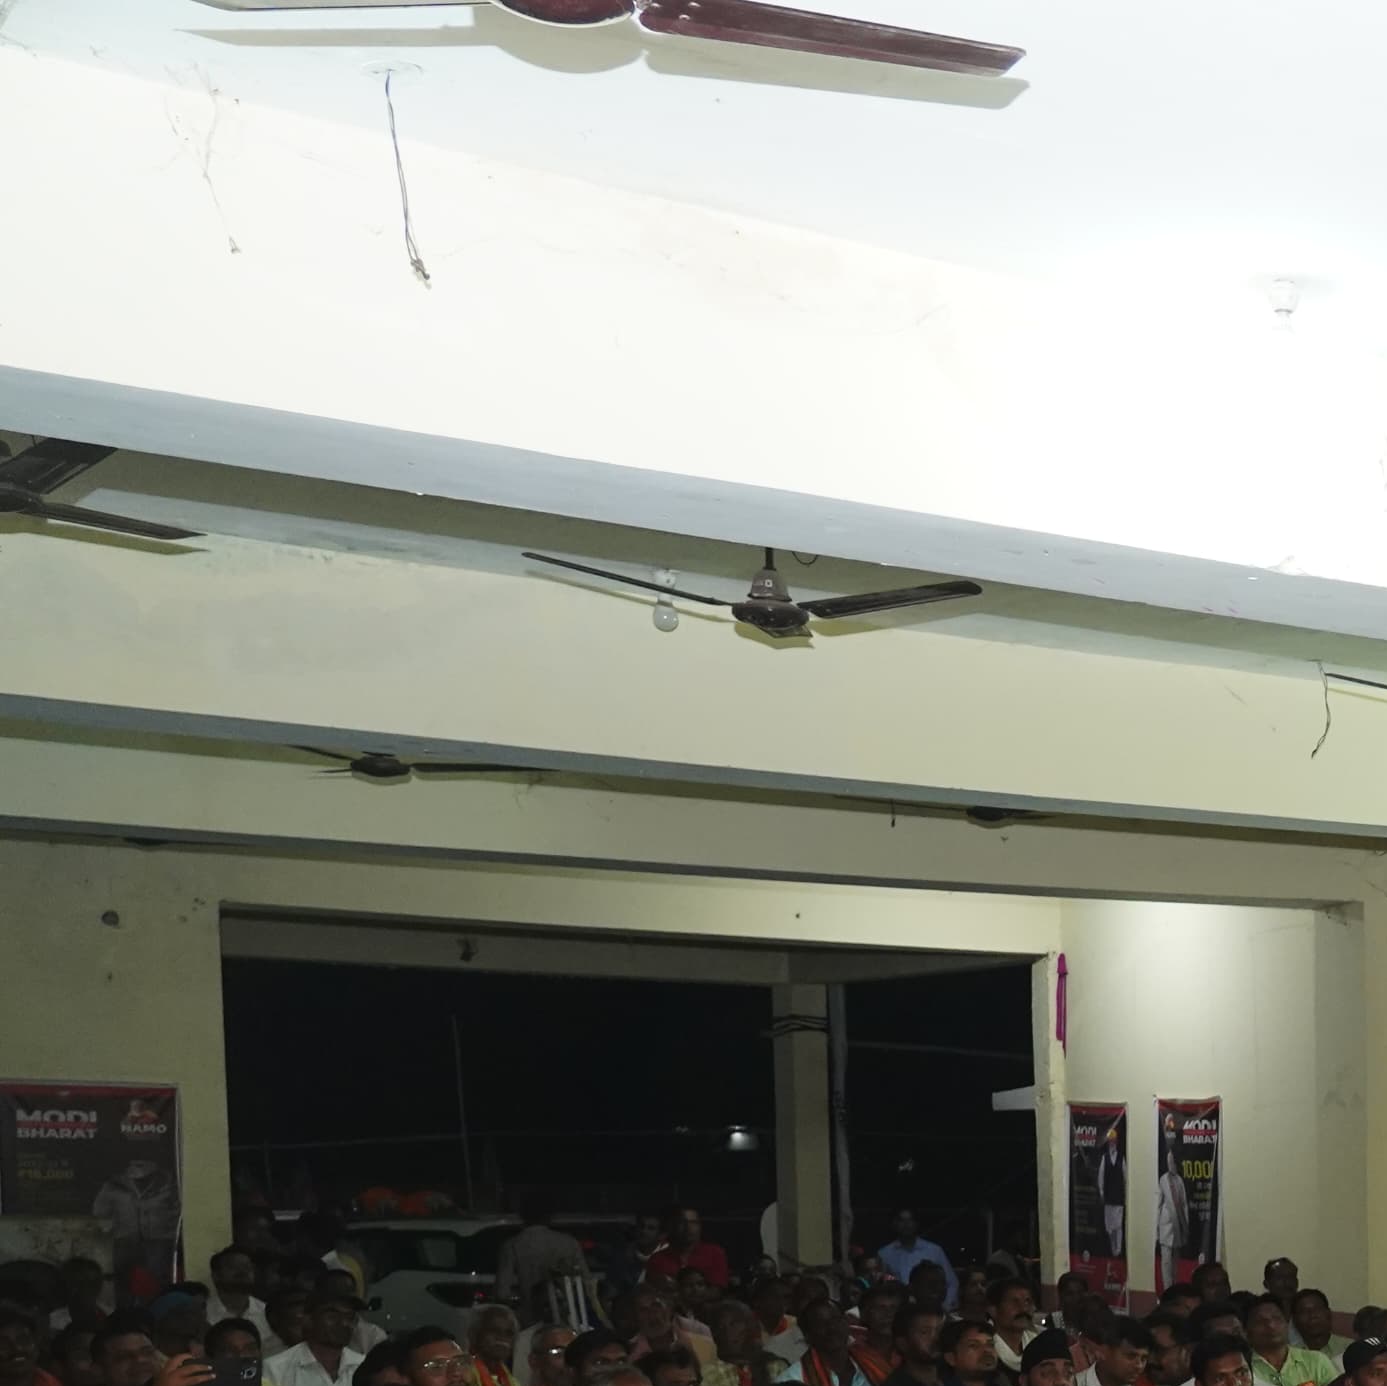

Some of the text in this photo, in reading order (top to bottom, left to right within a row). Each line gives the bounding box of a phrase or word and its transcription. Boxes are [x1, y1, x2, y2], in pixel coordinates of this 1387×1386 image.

[16, 1109, 97, 1123] MODI
[1183, 1119, 1217, 1130] MODI
[16, 1128, 97, 1139] BHARAT
